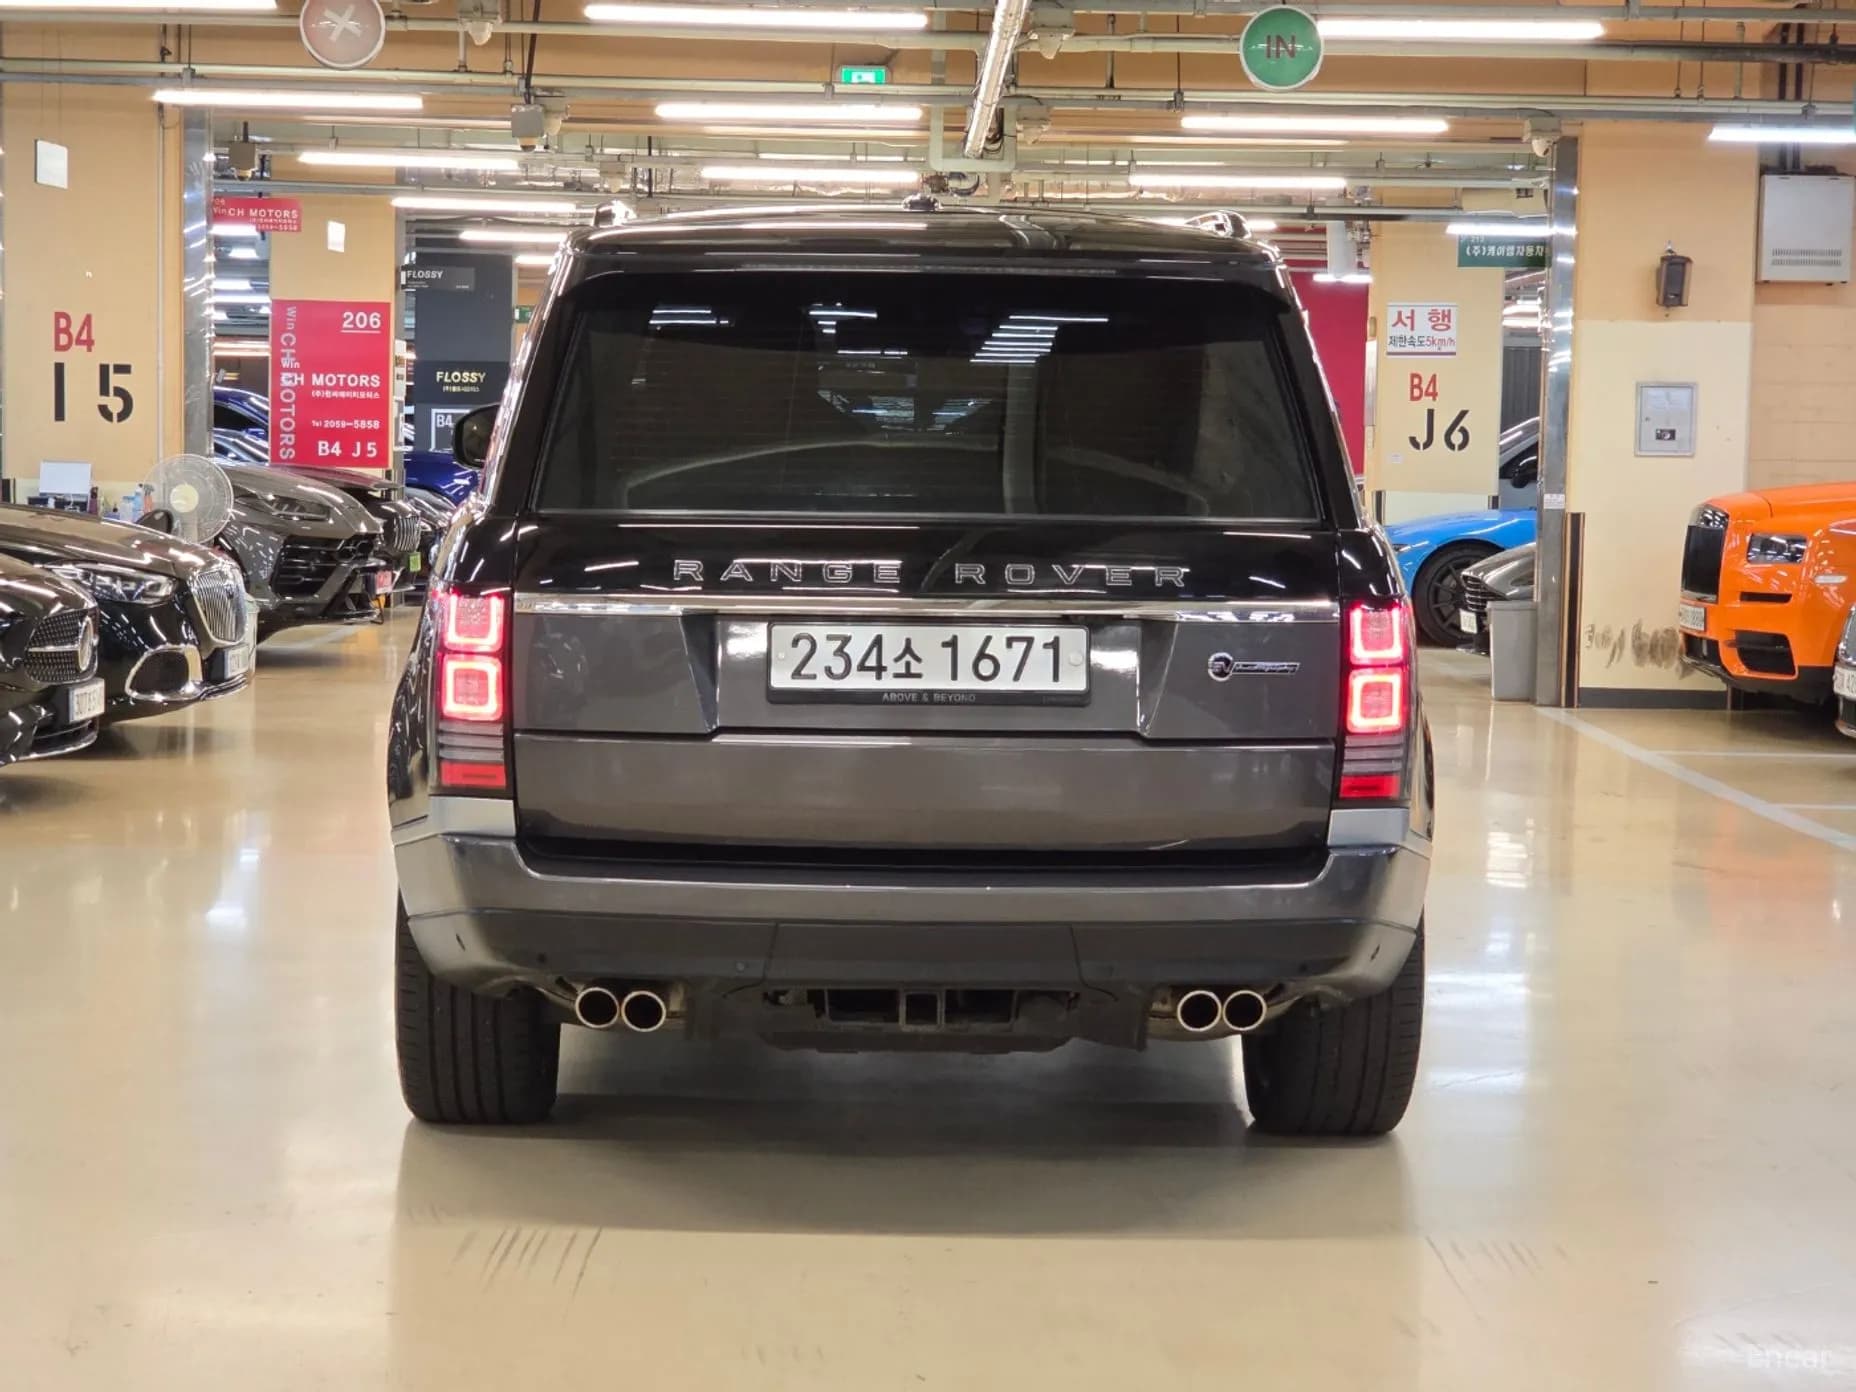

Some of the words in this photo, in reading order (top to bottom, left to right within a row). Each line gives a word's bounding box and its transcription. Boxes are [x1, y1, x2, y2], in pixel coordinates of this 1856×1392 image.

[1267, 35, 1296, 59] IN
[249, 208, 299, 219] MOTORS
[407, 270, 444, 279] FLOSSY
[342, 311, 381, 329] 206
[54, 311, 95, 352] B4
[311, 373, 381, 387] MOTORS
[436, 371, 487, 383] FLOSSY
[1409, 372, 1439, 402] B4
[317, 441, 342, 457] B4
[673, 559, 902, 584] RANGE
[954, 563, 1186, 587] ROVER
[790, 632, 923, 682] 234소
[940, 633, 1061, 683] 1671
[882, 692, 919, 702] ABOVE
[921, 692, 929, 702] &
[933, 692, 976, 703] BEYOND
